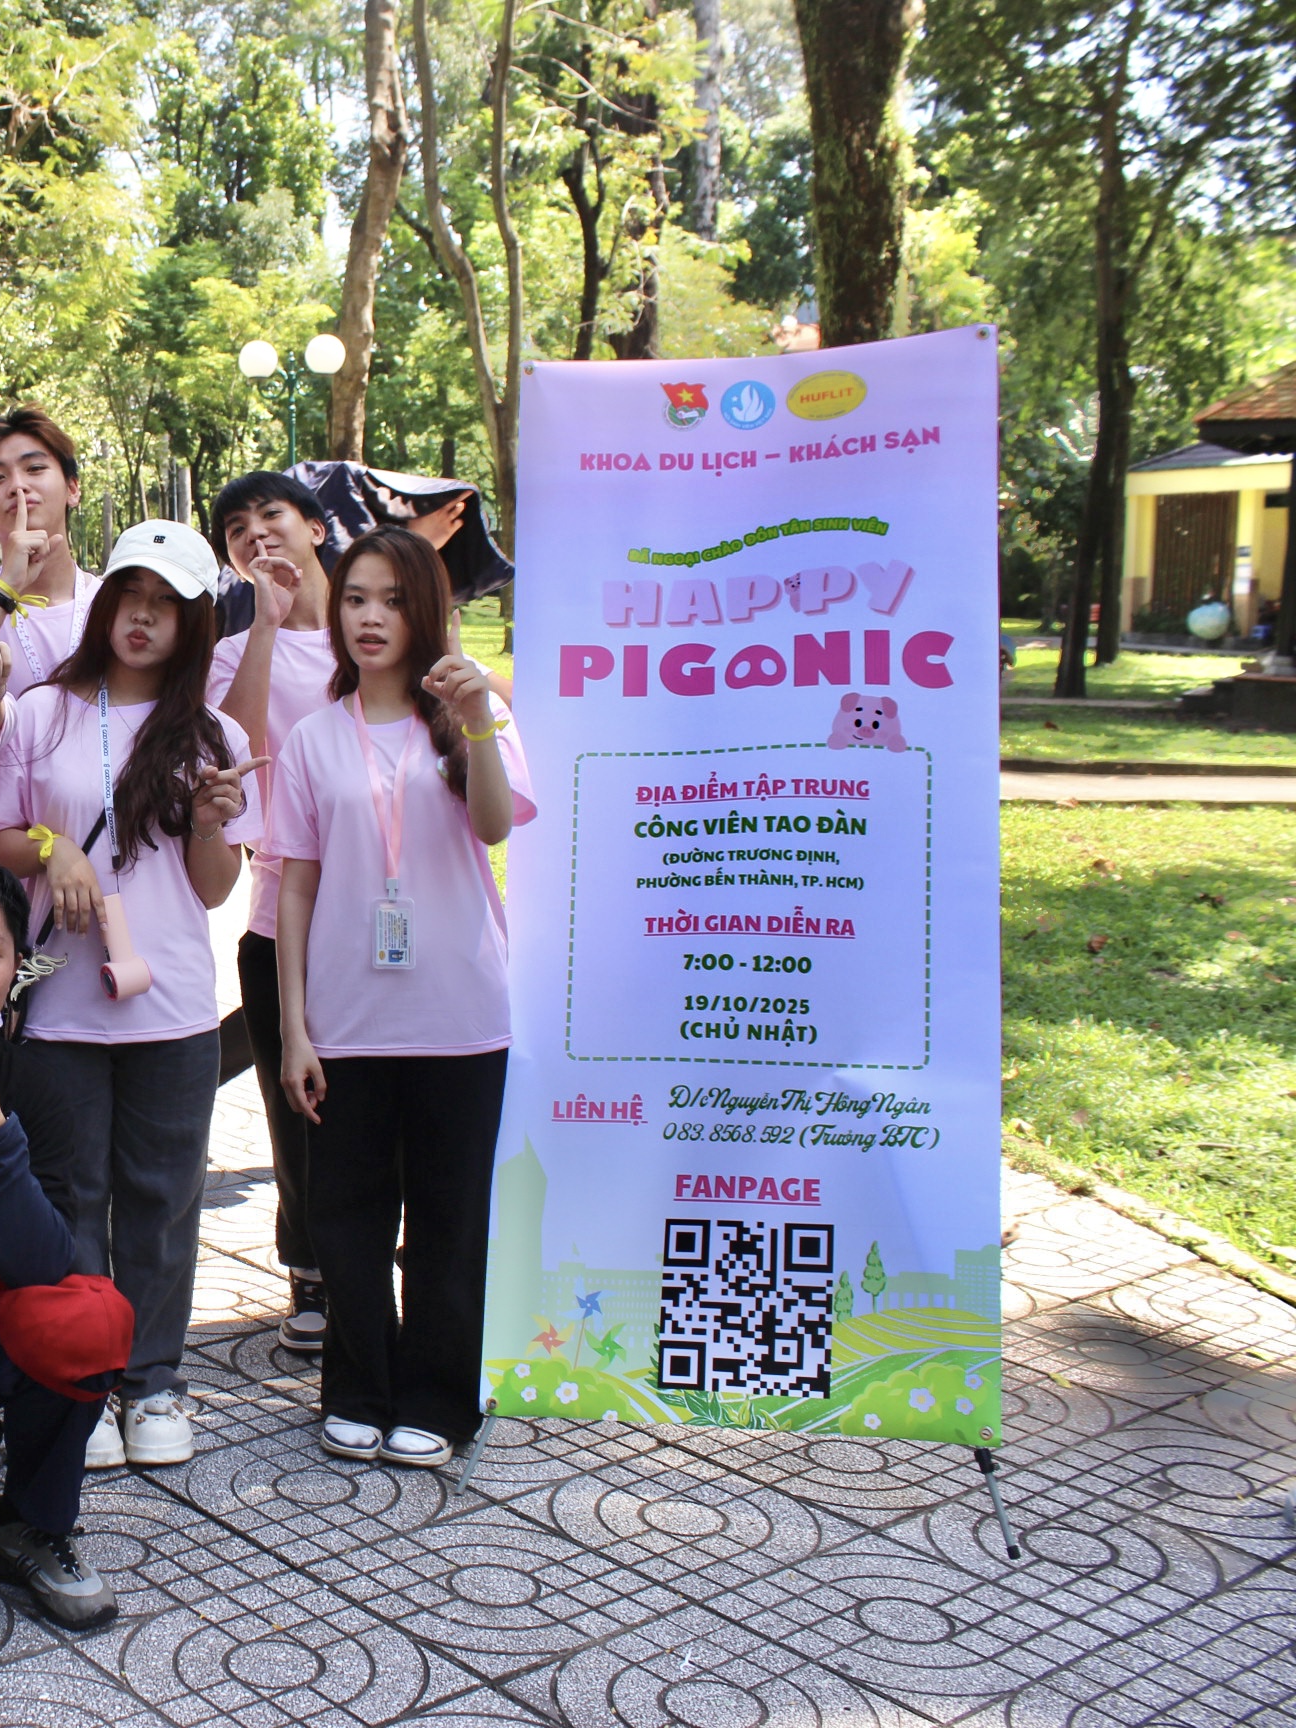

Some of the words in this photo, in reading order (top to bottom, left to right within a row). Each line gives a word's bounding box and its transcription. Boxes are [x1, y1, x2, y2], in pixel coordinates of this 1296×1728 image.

[798, 386, 854, 404] HUFLIT
[580, 453, 652, 472] KHOA
[659, 452, 694, 471] DU
[699, 450, 757, 478] LỊCH
[789, 434, 877, 463] KHÁCH
[884, 426, 941, 455] SẠN
[651, 551, 702, 568] NGOẠI
[701, 539, 744, 562] CHÀO
[743, 526, 780, 547] ĐÓN
[779, 518, 812, 536] TÂN
[812, 517, 851, 532] SINH
[851, 516, 890, 536] VIÊN
[602, 560, 916, 628] HAPPY
[636, 785, 677, 806] ĐỊA
[681, 771, 738, 800] ĐIỂM
[743, 773, 786, 801] TẬP
[791, 778, 870, 798] TRUNG
[634, 814, 698, 838] CÔNG
[703, 810, 758, 835] VIÊN
[764, 815, 811, 833] TAO
[816, 808, 867, 836] ĐÀN
[663, 847, 724, 866] (ĐƯỜNG
[728, 848, 793, 862] TRƯƠNG
[796, 849, 840, 866] ĐỊNH,
[636, 872, 701, 889] PHƯỜNG
[705, 867, 735, 887] BẾN
[739, 869, 798, 889] THÀNH,
[802, 874, 823, 888] TP.
[826, 876, 865, 891] HCM)
[645, 909, 699, 933] THỜI
[705, 915, 761, 932] GIAN
[767, 906, 821, 935] DIỄN
[826, 918, 856, 936] RA
[683, 953, 734, 971] 7:00
[752, 954, 812, 974] 12:00
[684, 994, 810, 1015] 19/10/2025
[679, 1016, 740, 1041] (CHỦ
[747, 1018, 818, 1048] NHẬT)
[553, 1093, 605, 1119] LIÊN
[611, 1094, 644, 1126] HỆ
[708, 1087, 780, 1116] Nguyễn
[780, 1088, 812, 1115] Thị
[815, 1091, 872, 1119] Hồng
[871, 1092, 932, 1120] Ngân
[759, 1125, 795, 1145] 592
[676, 1174, 821, 1202] FANPAGE
